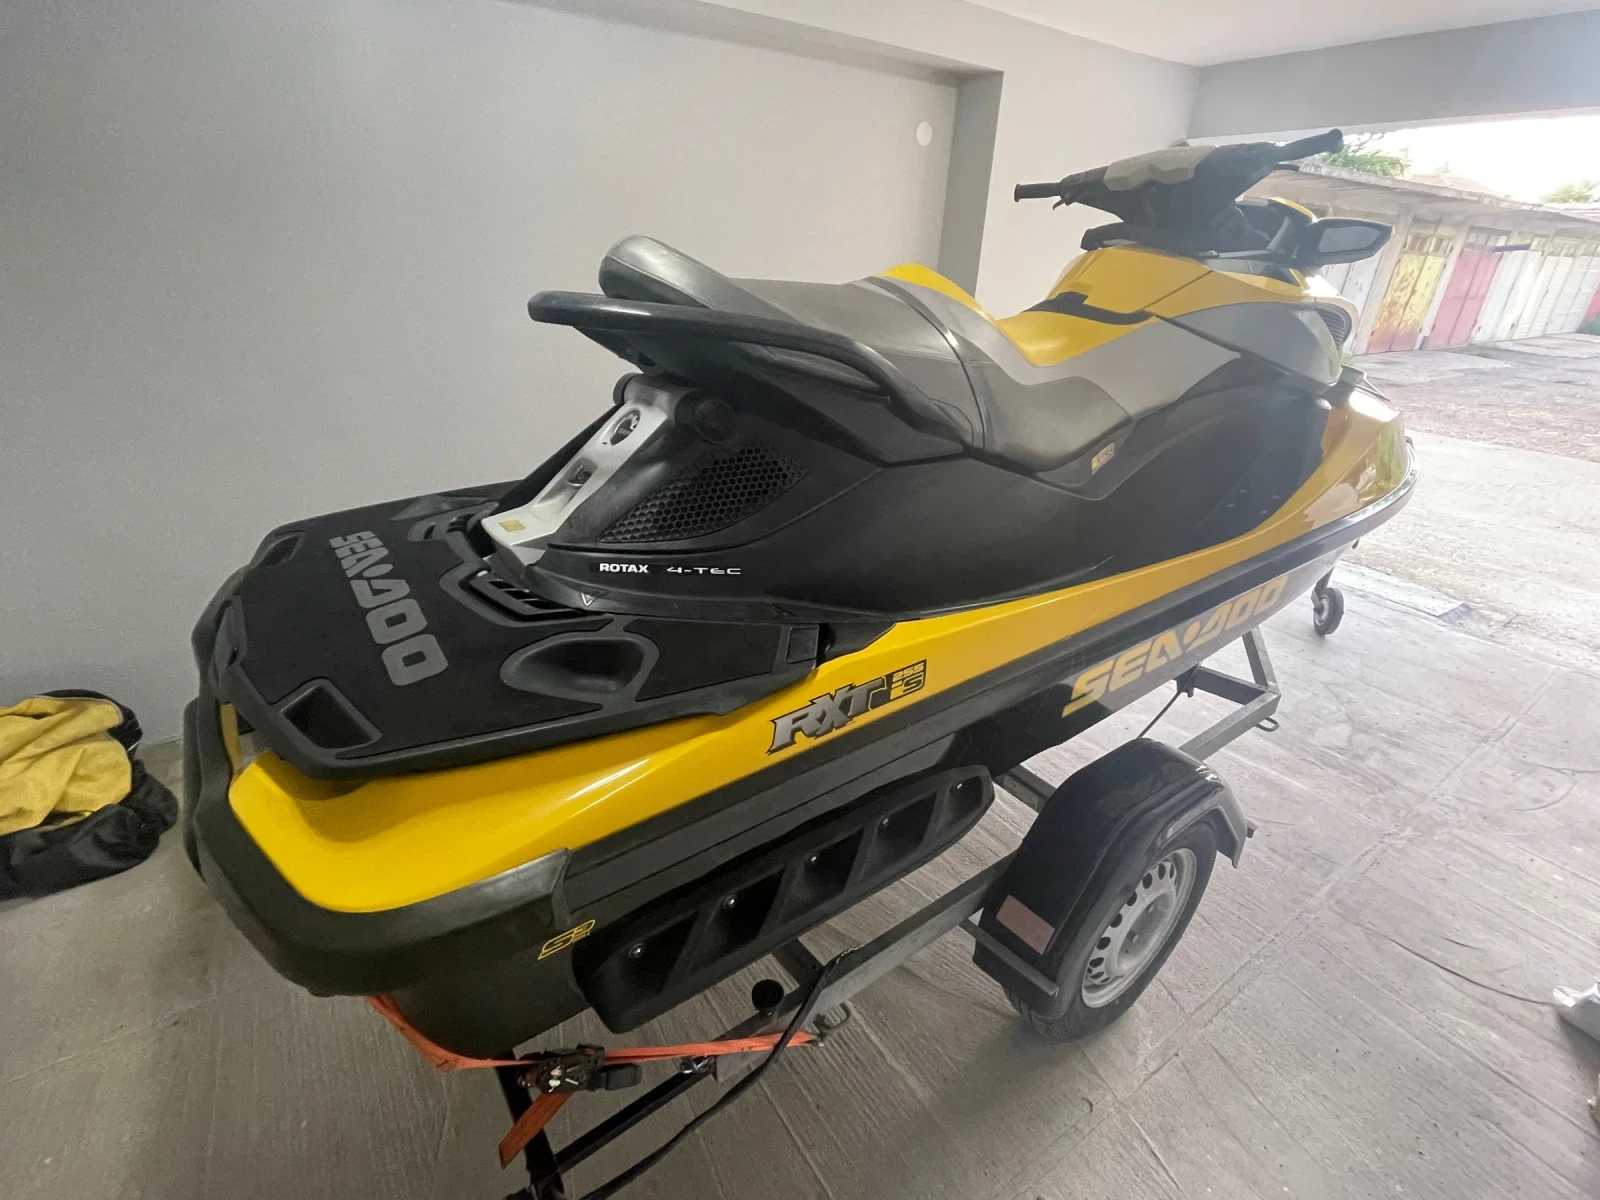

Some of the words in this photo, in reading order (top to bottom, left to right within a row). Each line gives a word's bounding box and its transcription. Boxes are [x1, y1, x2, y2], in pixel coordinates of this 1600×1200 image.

[599, 562, 650, 574] ROTAX
[666, 566, 742, 575] 4-TEC
[767, 675, 886, 755] RXT
